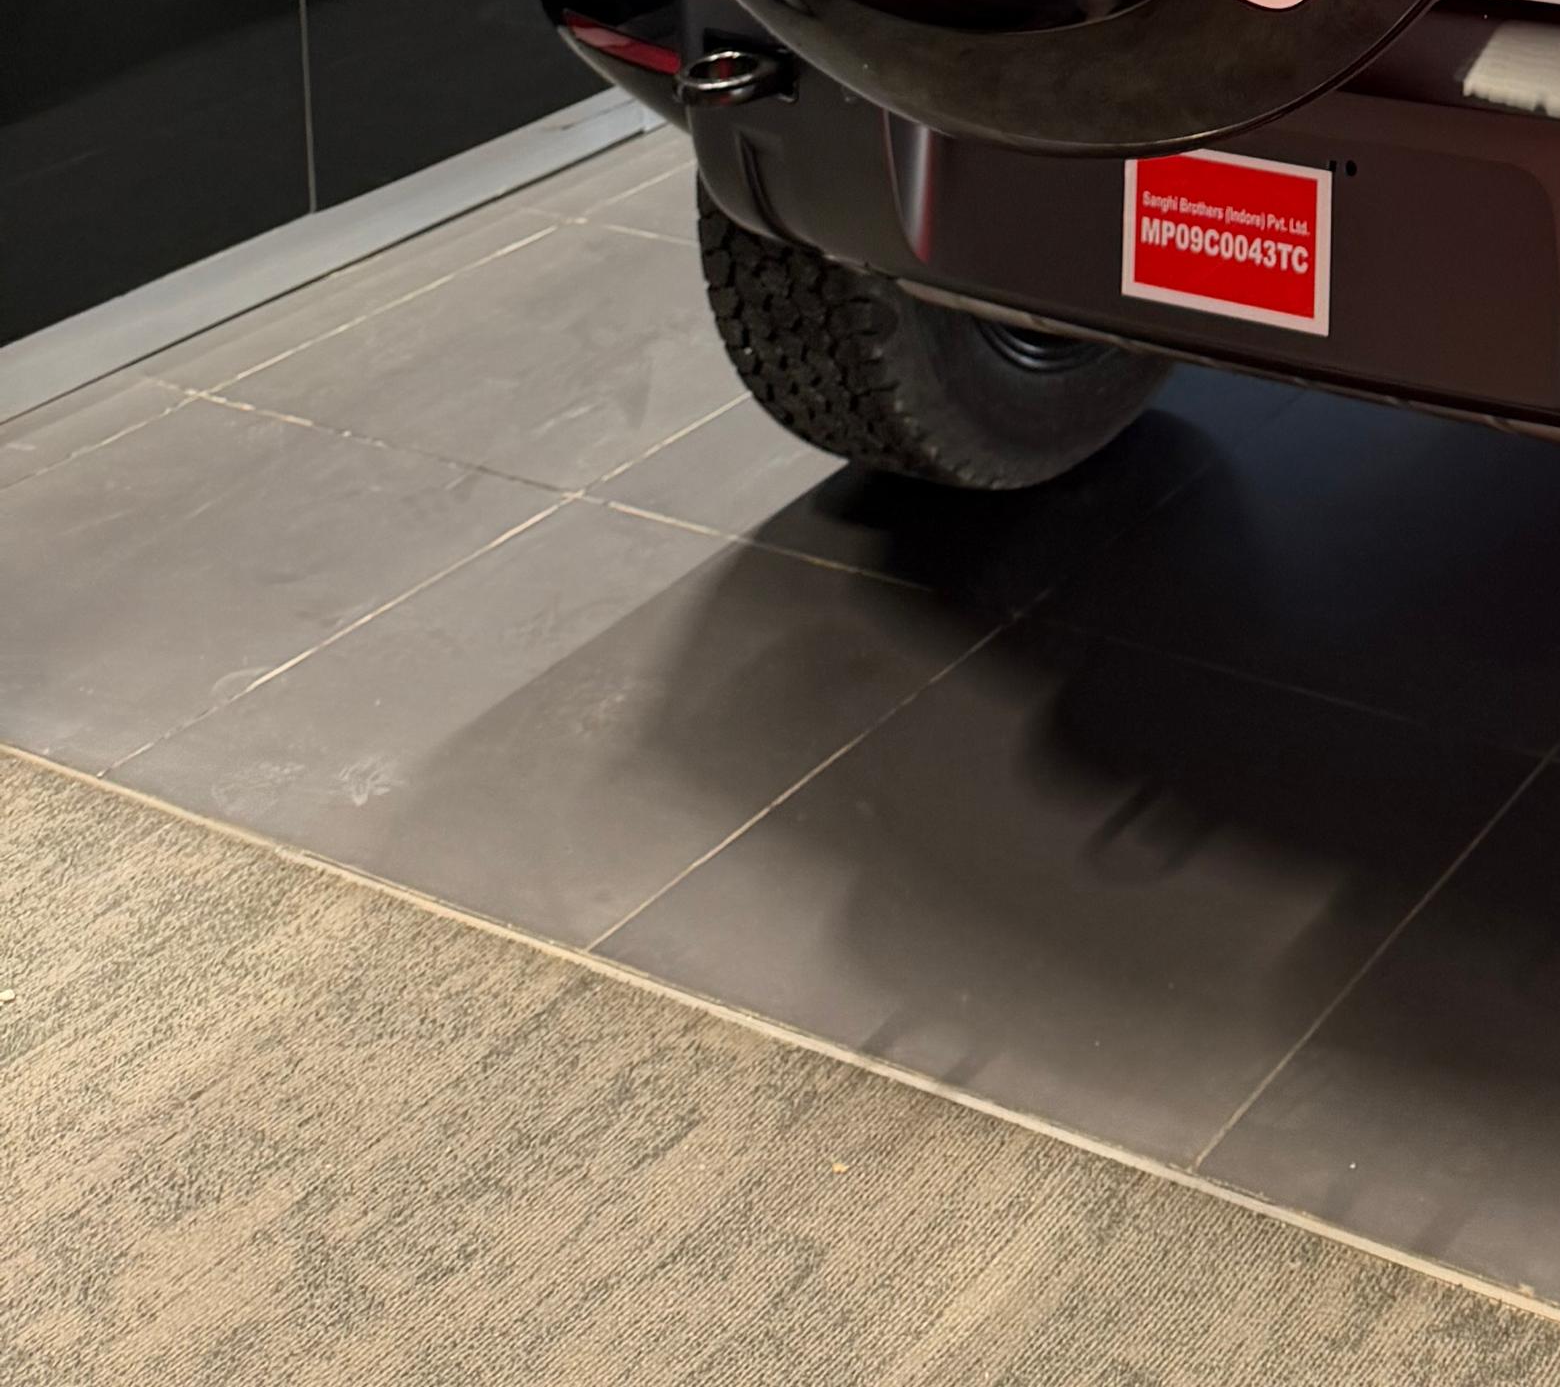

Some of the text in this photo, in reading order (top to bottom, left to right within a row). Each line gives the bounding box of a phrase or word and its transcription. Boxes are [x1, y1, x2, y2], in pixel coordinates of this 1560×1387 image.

[1142, 190, 1310, 237] Sanghi Brothers (Indore) Pvt. Ltd.
[1140, 216, 1309, 274] MP09C0043TC
